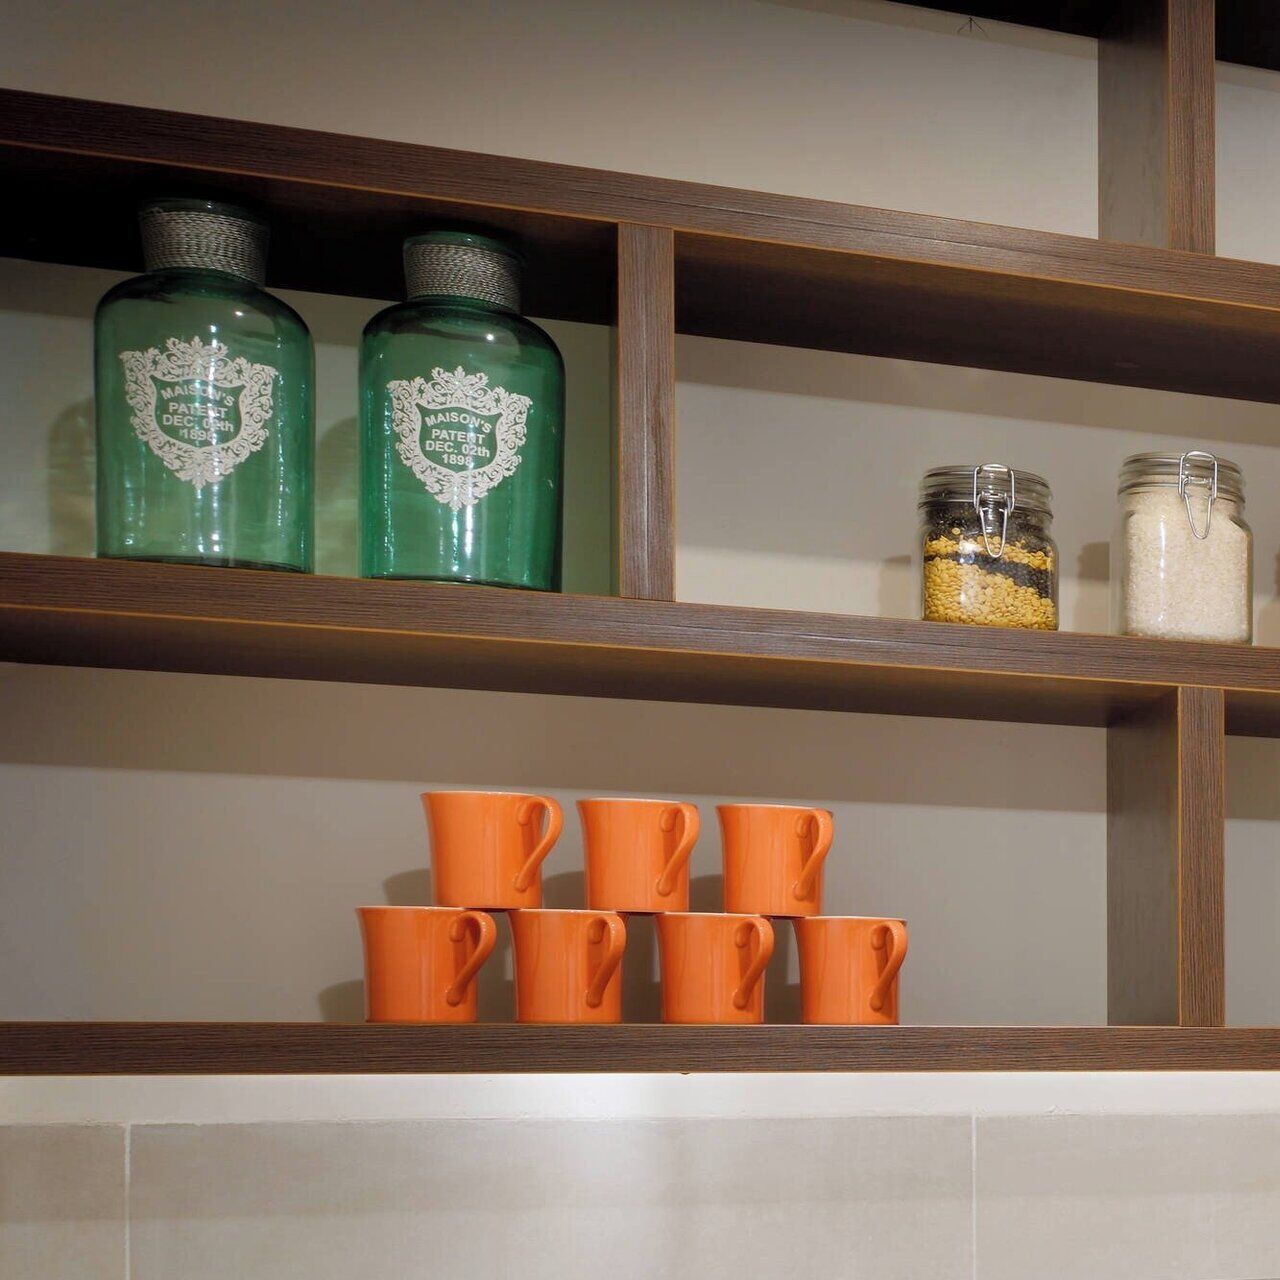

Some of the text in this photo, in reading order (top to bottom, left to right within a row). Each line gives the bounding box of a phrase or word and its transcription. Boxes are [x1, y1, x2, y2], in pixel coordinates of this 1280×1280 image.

[161, 384, 235, 407] MAISON'S
[168, 402, 228, 418] PATENT
[424, 411, 492, 433] MAISON'S
[431, 428, 486, 445] PATENT
[425, 440, 490, 458] DEC. 02th
[442, 453, 474, 467] 1898
